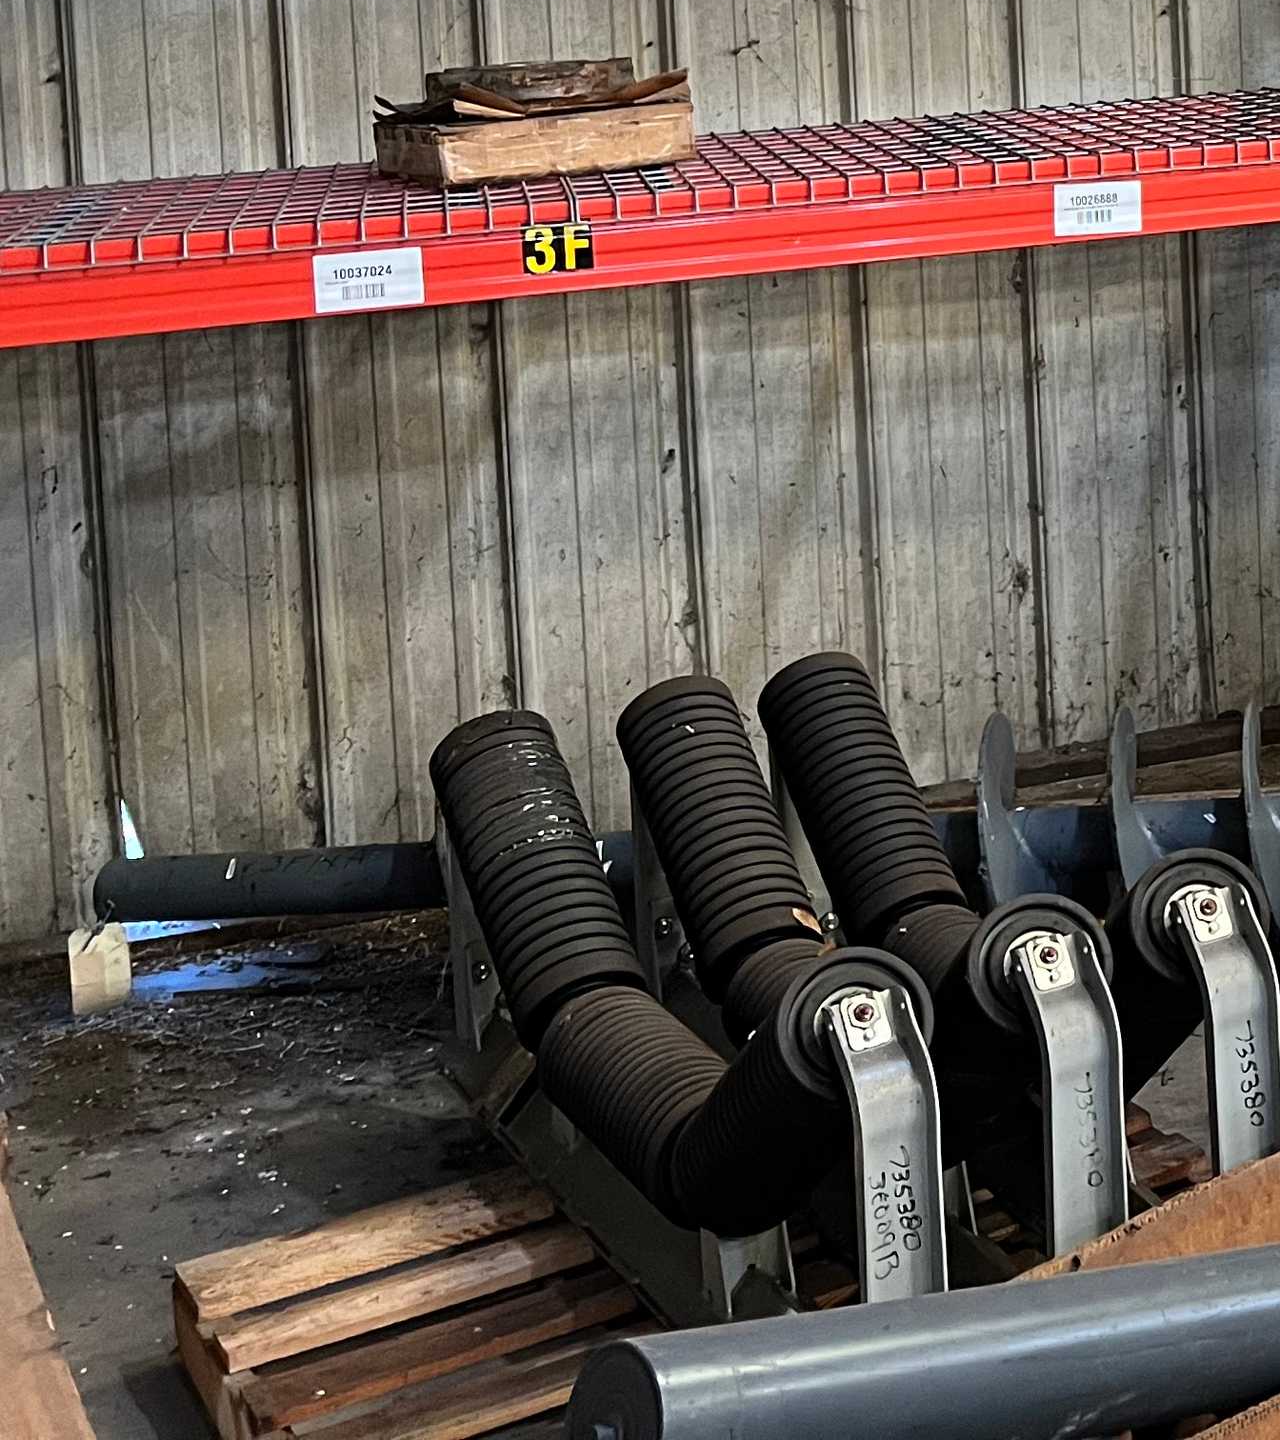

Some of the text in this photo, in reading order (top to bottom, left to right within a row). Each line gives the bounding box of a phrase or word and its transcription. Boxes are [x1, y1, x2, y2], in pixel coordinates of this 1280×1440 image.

[332, 264, 393, 280] 10037024
[523, 221, 590, 275] 3F
[1234, 1019, 1267, 1128] 735380
[891, 1144, 923, 1252] 735380
